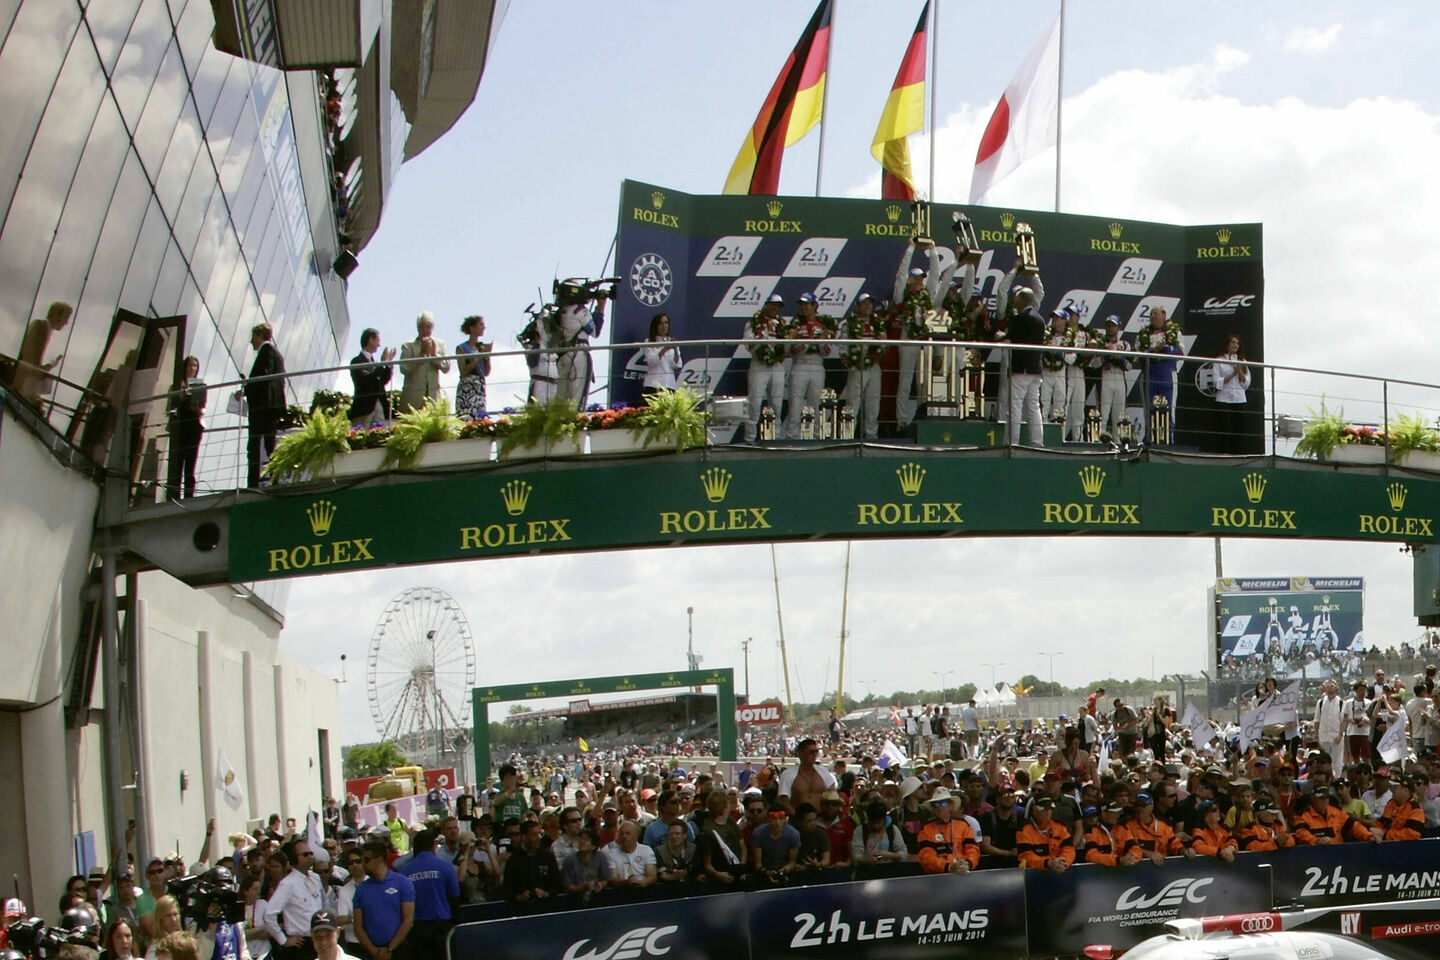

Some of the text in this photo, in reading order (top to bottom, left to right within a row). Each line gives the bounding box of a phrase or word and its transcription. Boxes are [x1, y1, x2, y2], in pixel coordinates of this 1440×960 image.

[633, 207, 680, 229] ROLEX
[745, 220, 803, 233] ROLEX
[714, 246, 743, 261] 24h
[1090, 238, 1141, 254] ROLEX
[1197, 246, 1251, 258] ROLEX
[800, 247, 828, 262] 24h
[1122, 266, 1146, 282] 24h
[732, 286, 761, 301] 24h
[1204, 294, 1255, 309] WEC
[660, 506, 771, 534] ROLEX
[857, 502, 964, 525] ROLEX
[1043, 502, 1140, 525] ROLEX
[1211, 507, 1297, 531] ROLEX
[1359, 513, 1434, 537] ROLEX
[460, 518, 571, 550] ROLEX
[269, 538, 375, 572] ROLEX
[1241, 580, 1288, 588] MICHELIN
[1315, 579, 1361, 587] MICHELIN
[1259, 606, 1286, 614] ROEX
[1301, 865, 1347, 897] 24h
[1353, 874, 1383, 893] LE
[1115, 877, 1215, 910] WEC
[1088, 908, 1179, 924] FIA WORLD ENDURANCE
[1341, 912, 1361, 935] HY
[790, 908, 989, 948] 24h LE MANS
[1385, 924, 1412, 936] Audi
[917, 930, 985, 945] 14-15 JUIN 2014
[1299, 947, 1320, 956] ORIS
